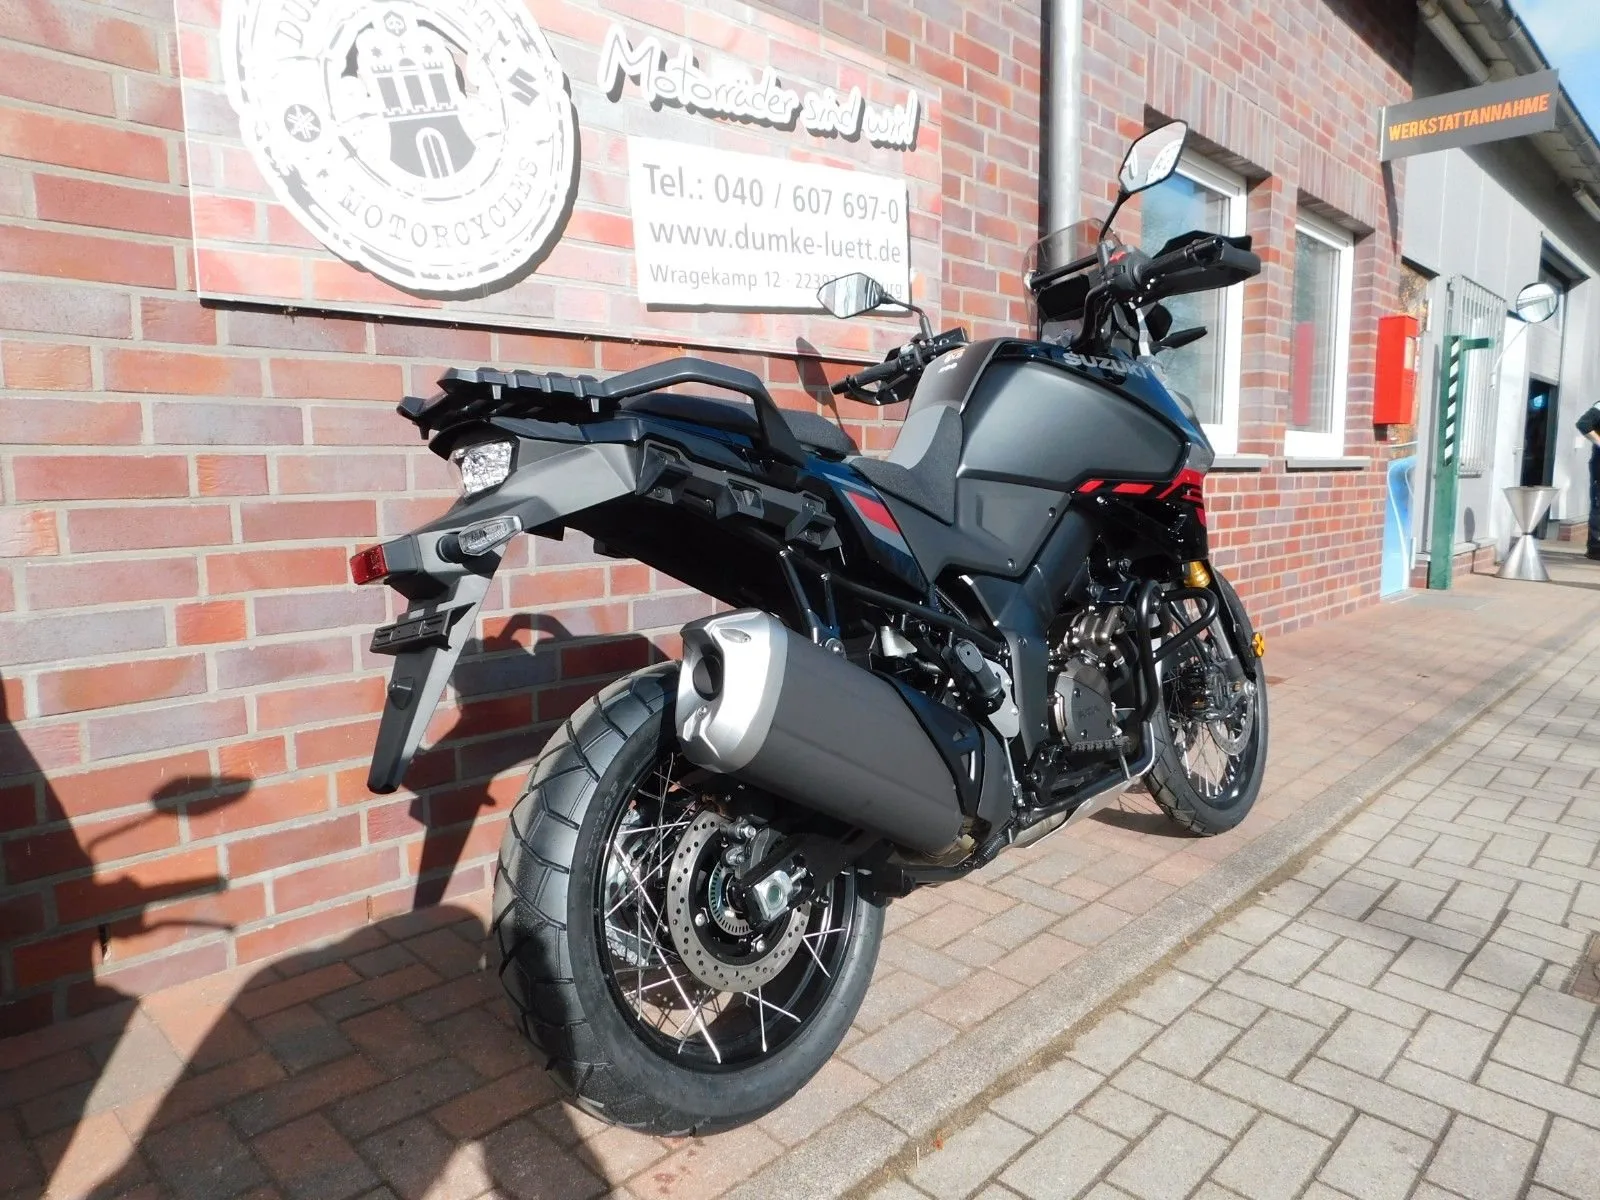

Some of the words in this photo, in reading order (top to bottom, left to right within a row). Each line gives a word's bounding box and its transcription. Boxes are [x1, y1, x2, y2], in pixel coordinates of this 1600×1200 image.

[599, 28, 799, 122] Motorräder
[802, 87, 862, 134] sind
[1388, 92, 1552, 142] WERKSTATTANNAHME
[338, 155, 539, 248] MOTORCYCLES
[643, 162, 703, 201] Tel.:
[714, 173, 764, 208] 040
[792, 185, 833, 217] 607
[843, 192, 900, 225] 697-0
[648, 220, 902, 265] www.dumke-luett.de
[648, 263, 758, 292] Wragekamp
[765, 271, 782, 289] 12
[1062, 352, 1148, 379] SUZUKI
